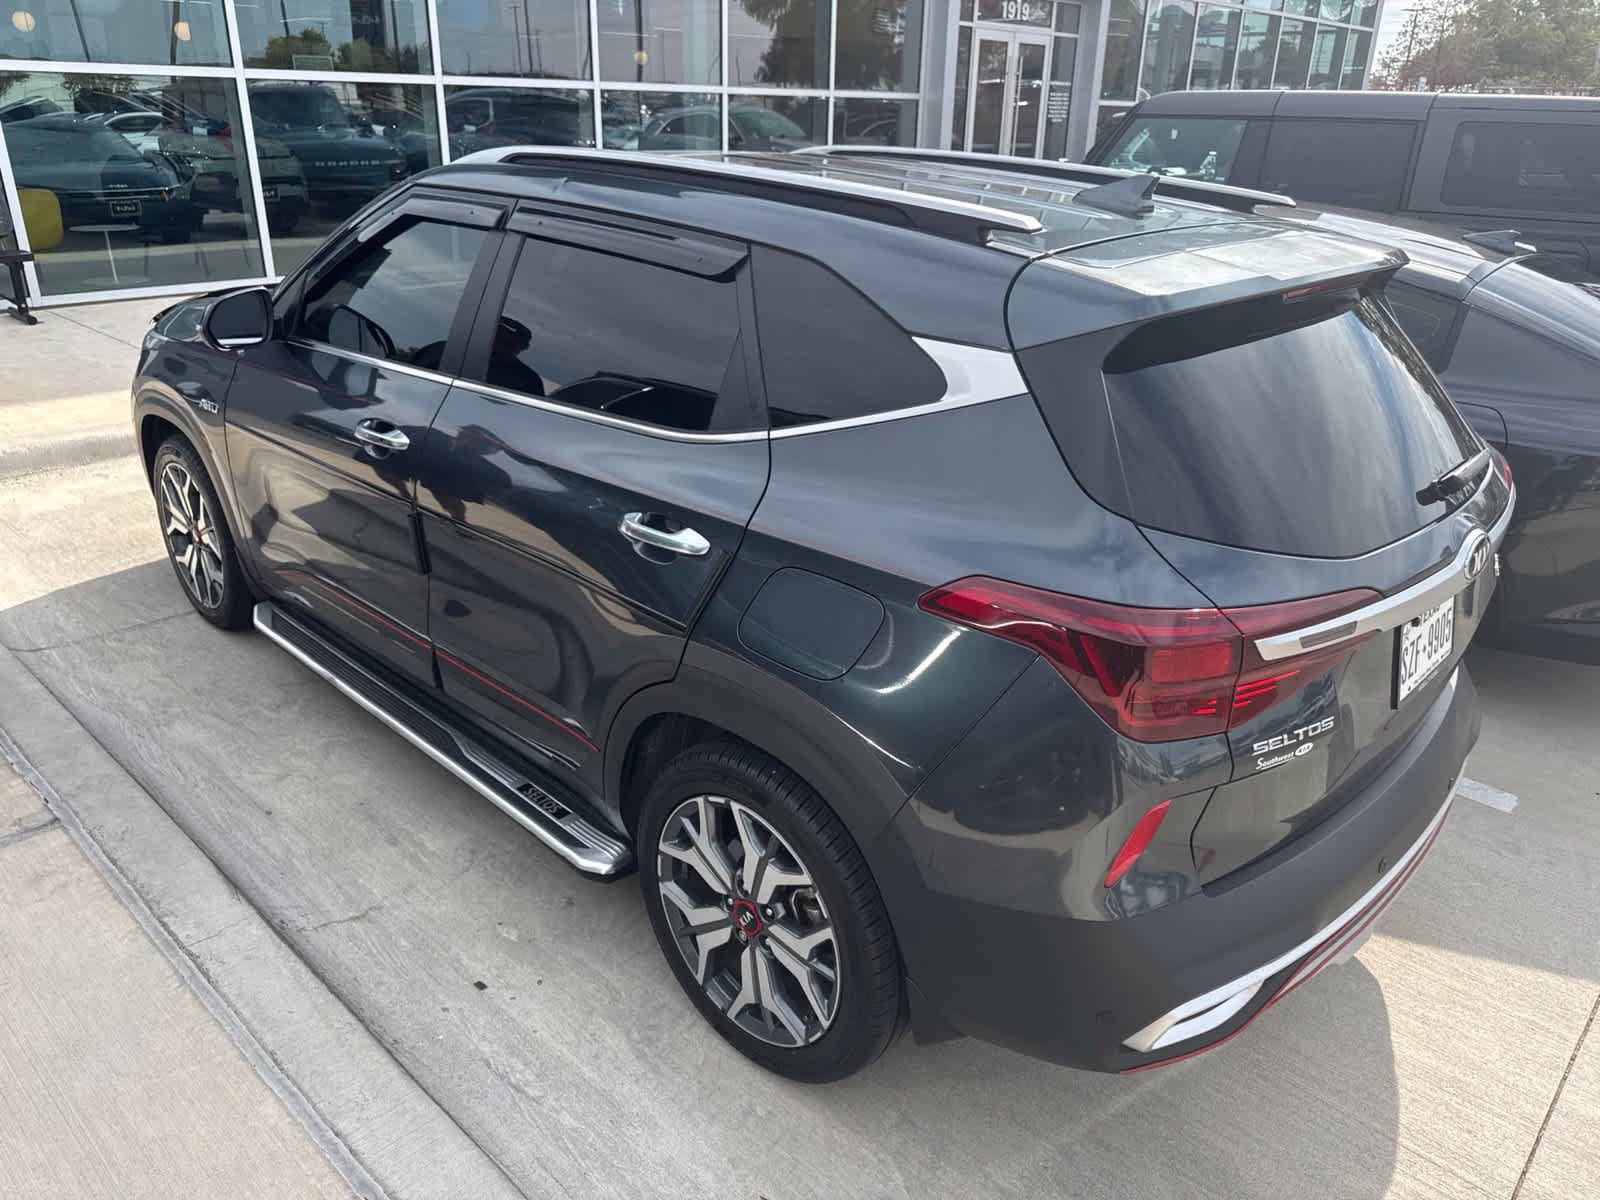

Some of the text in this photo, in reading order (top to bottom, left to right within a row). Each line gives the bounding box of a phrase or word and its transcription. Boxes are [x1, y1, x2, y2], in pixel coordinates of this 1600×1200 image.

[1002, 0, 1029, 20] 1919
[1251, 716, 1335, 756] SELTOS
[1256, 750, 1295, 770] Southwest
[524, 786, 561, 814] SELTOS
[739, 911, 754, 926] KIA
